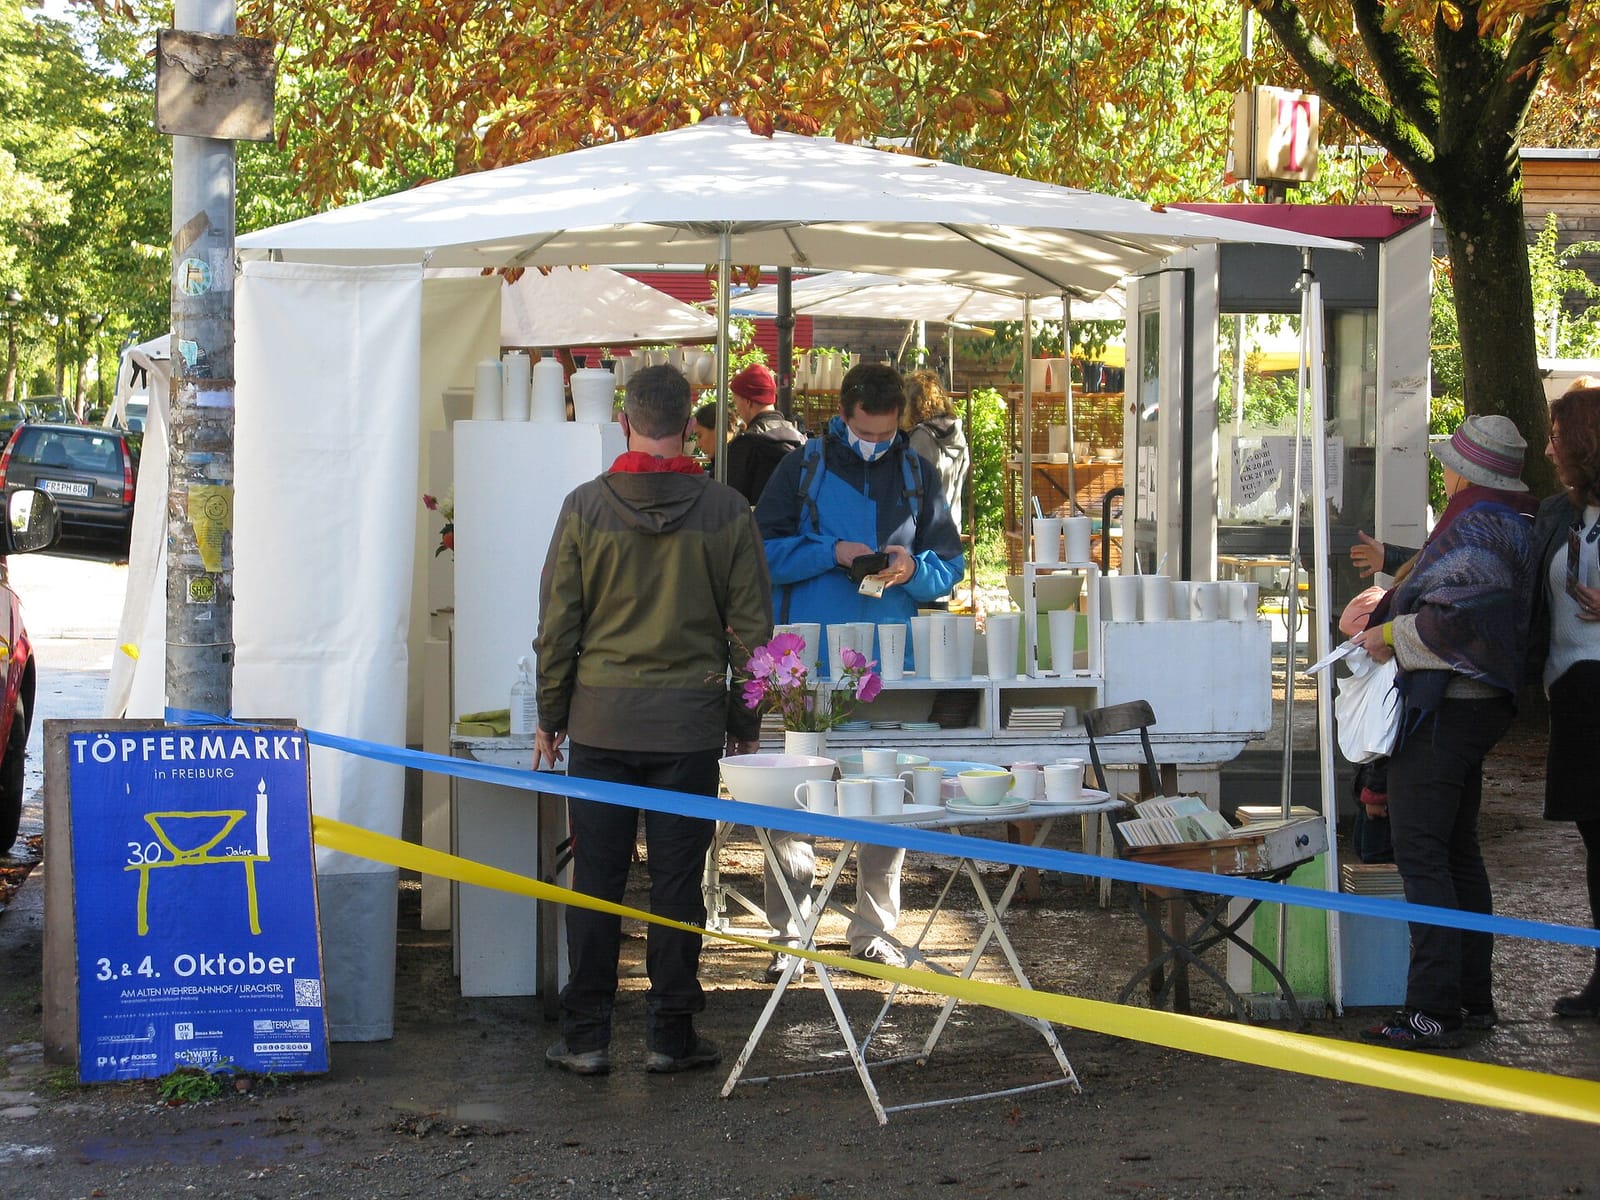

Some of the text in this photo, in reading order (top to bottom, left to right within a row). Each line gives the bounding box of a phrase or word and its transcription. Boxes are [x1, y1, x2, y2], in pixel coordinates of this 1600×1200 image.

[1278, 99, 1311, 172] T
[191, 585, 213, 596] SHOP
[73, 733, 302, 763] TÖPFERMARKT
[154, 767, 235, 780] in FREIBURG
[127, 842, 162, 865] 30
[96, 952, 296, 981] 3. & 4. Oktober
[120, 989, 136, 998] AM
[137, 987, 162, 997] ALTEN
[163, 984, 234, 996] WIEHREBAHNHOF
[239, 983, 284, 993] URACHSTR.
[177, 1024, 190, 1032] OK
[174, 1049, 218, 1059] schwarz
